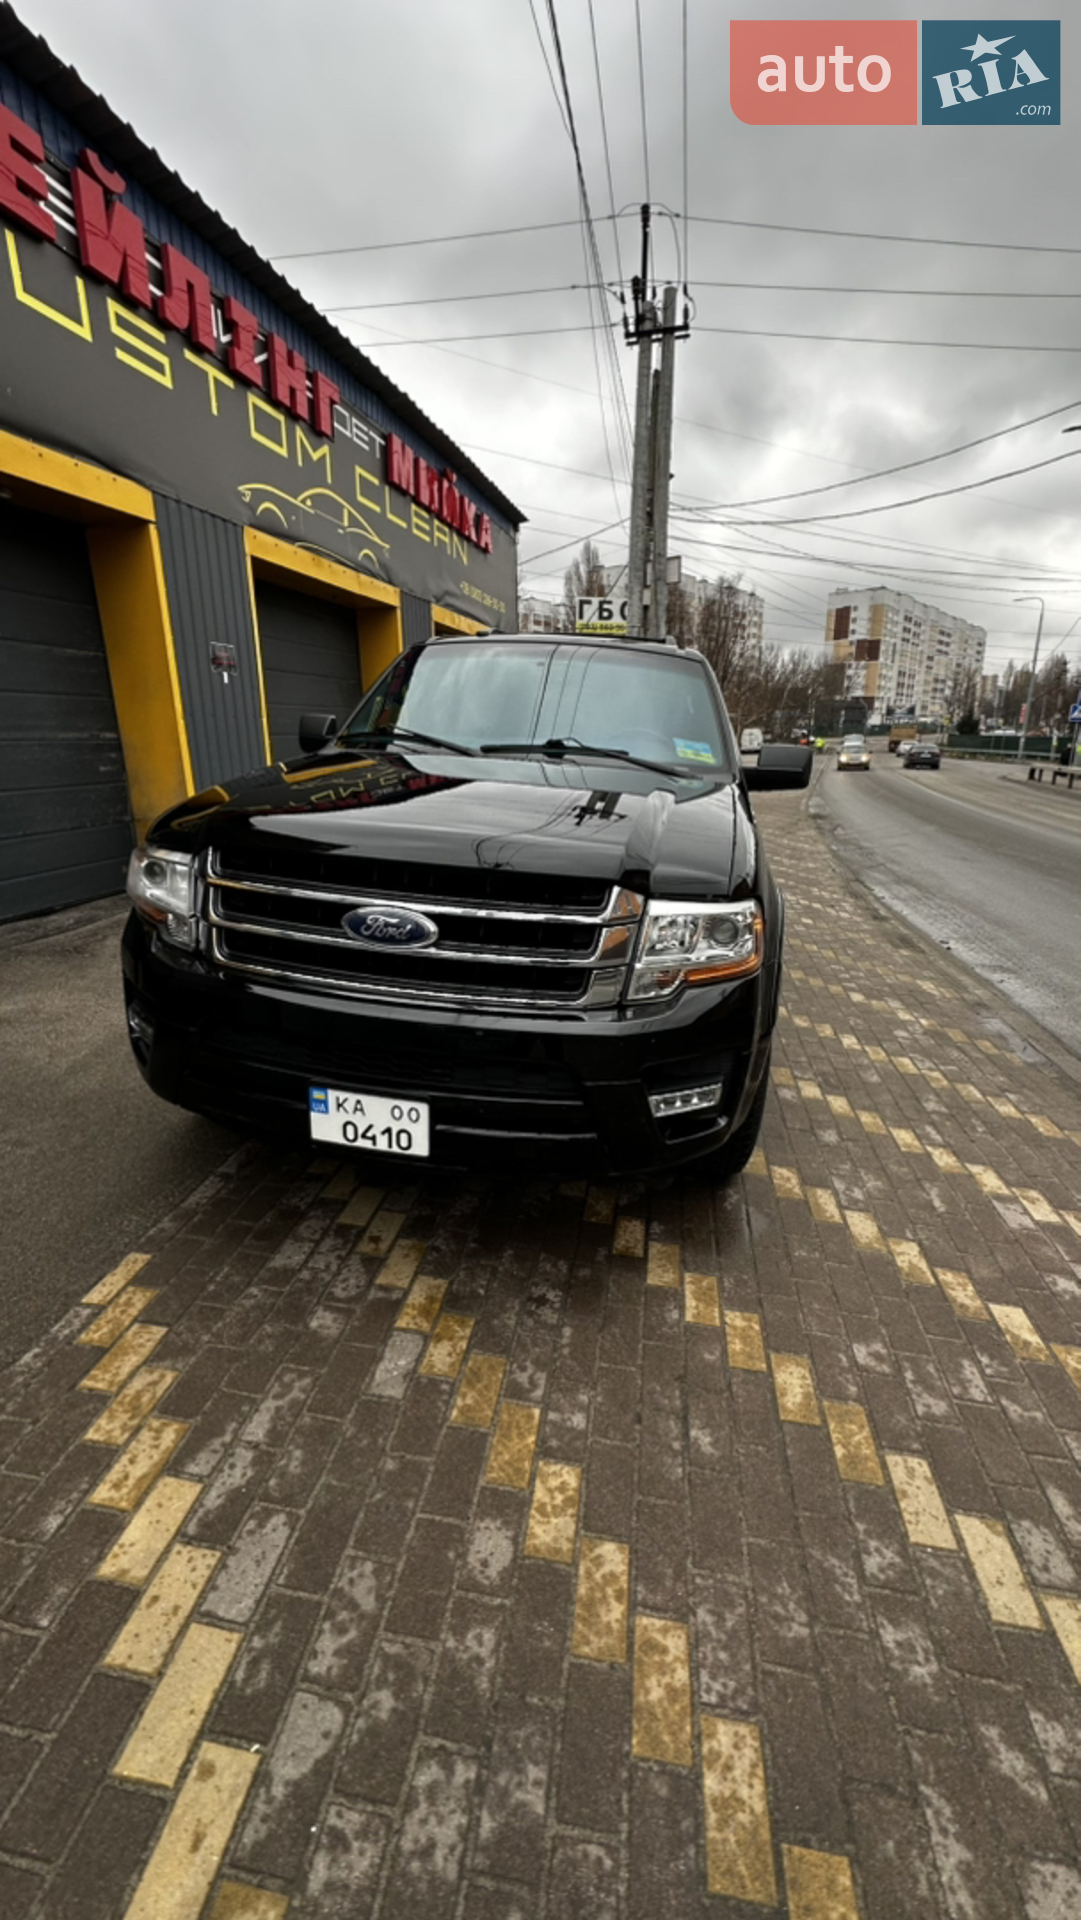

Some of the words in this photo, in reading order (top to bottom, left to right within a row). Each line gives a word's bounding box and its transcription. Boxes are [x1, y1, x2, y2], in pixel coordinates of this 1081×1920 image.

[354, 464, 468, 566] CLEAN
[361, 914, 412, 940] Ford
[336, 1096, 366, 1117] KA
[390, 1104, 420, 1124] 00
[342, 1120, 413, 1152] 0410
